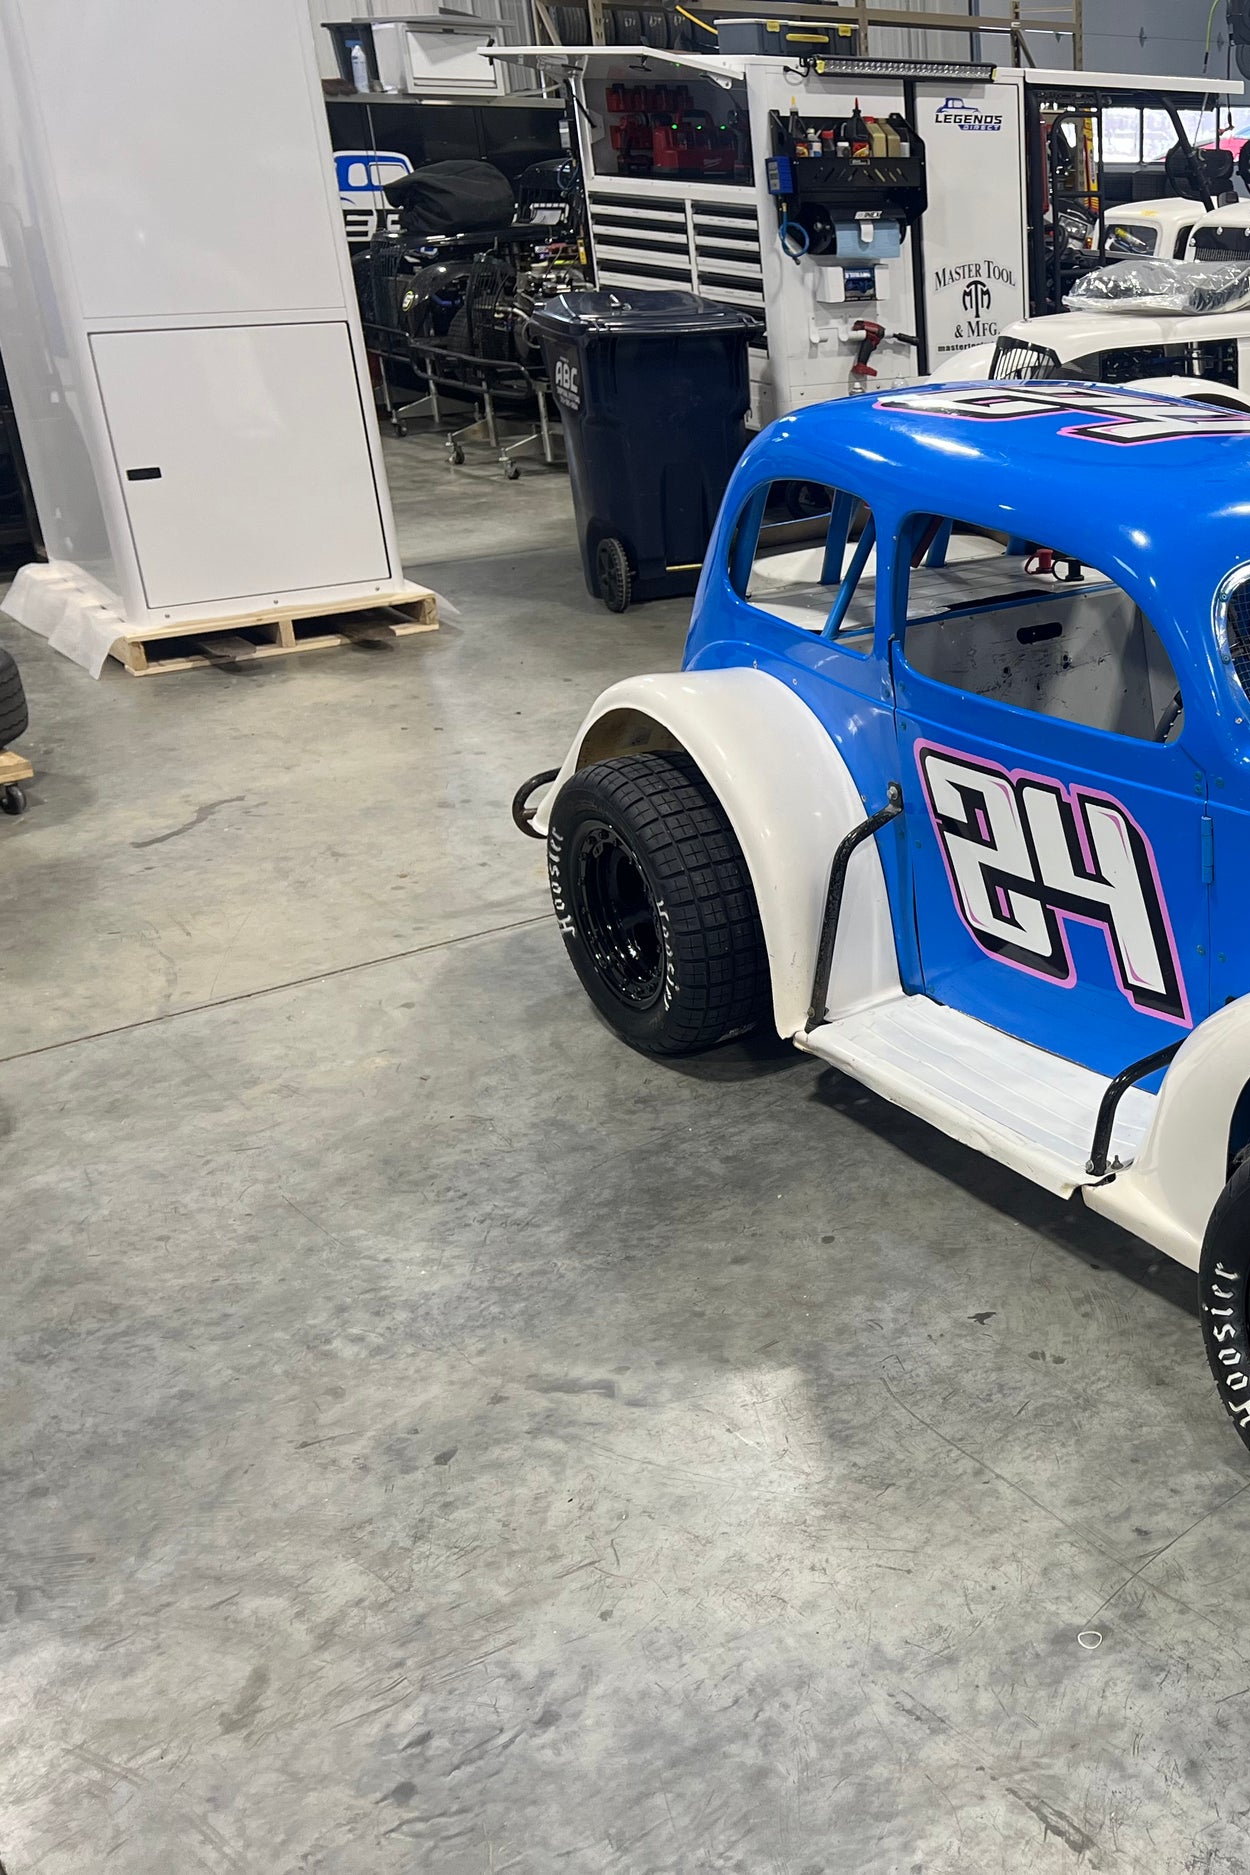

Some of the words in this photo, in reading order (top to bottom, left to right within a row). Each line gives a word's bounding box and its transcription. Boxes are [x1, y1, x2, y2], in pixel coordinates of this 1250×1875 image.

[935, 113, 1003, 125] LEGENDS
[954, 324, 963, 338] &
[555, 361, 578, 393] ABC
[914, 738, 1193, 1029] 24
